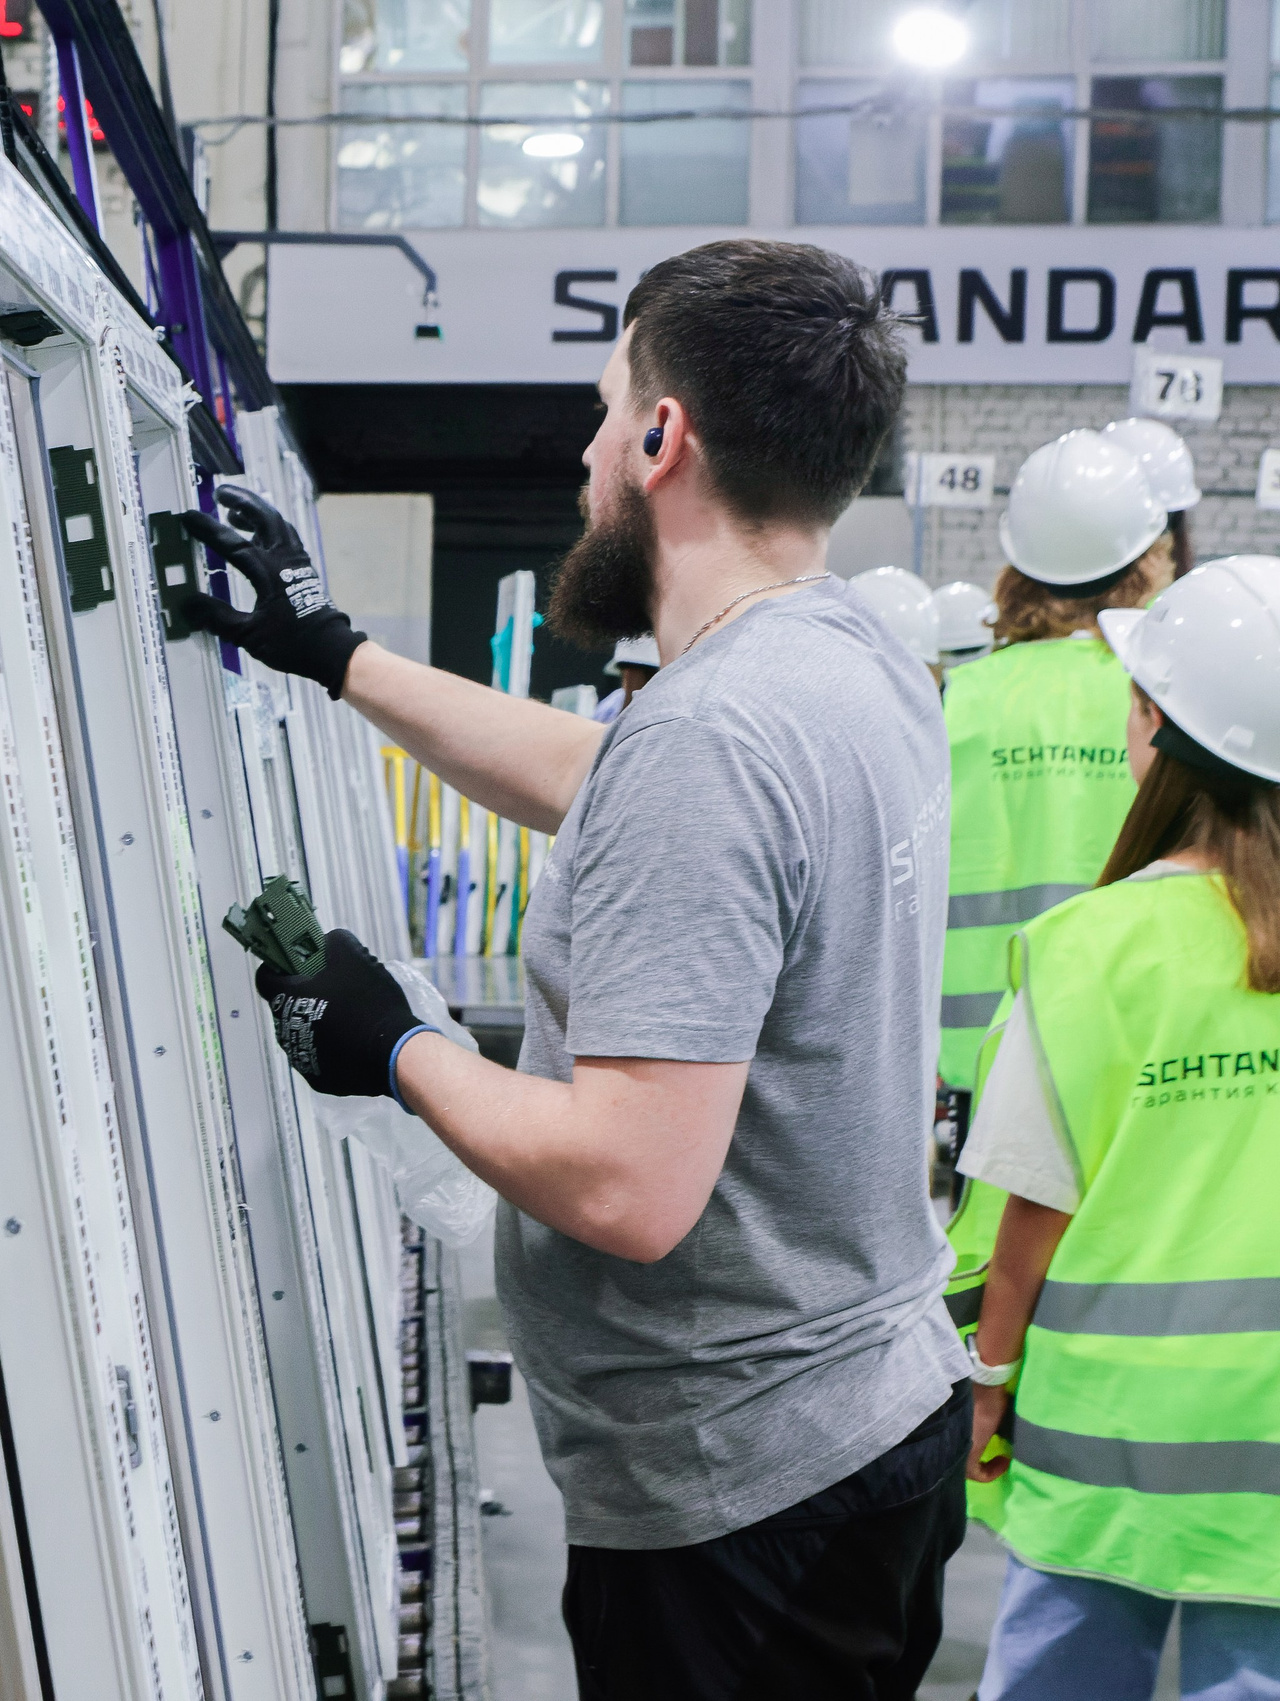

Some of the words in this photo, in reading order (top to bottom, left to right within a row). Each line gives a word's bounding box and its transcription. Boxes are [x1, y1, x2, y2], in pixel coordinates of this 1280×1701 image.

[551, 268, 1280, 344] SANDAR
[939, 466, 980, 490] 48
[1137, 1048, 1279, 1086] SCHTAN
[1131, 1084, 1256, 1109] гарантия
